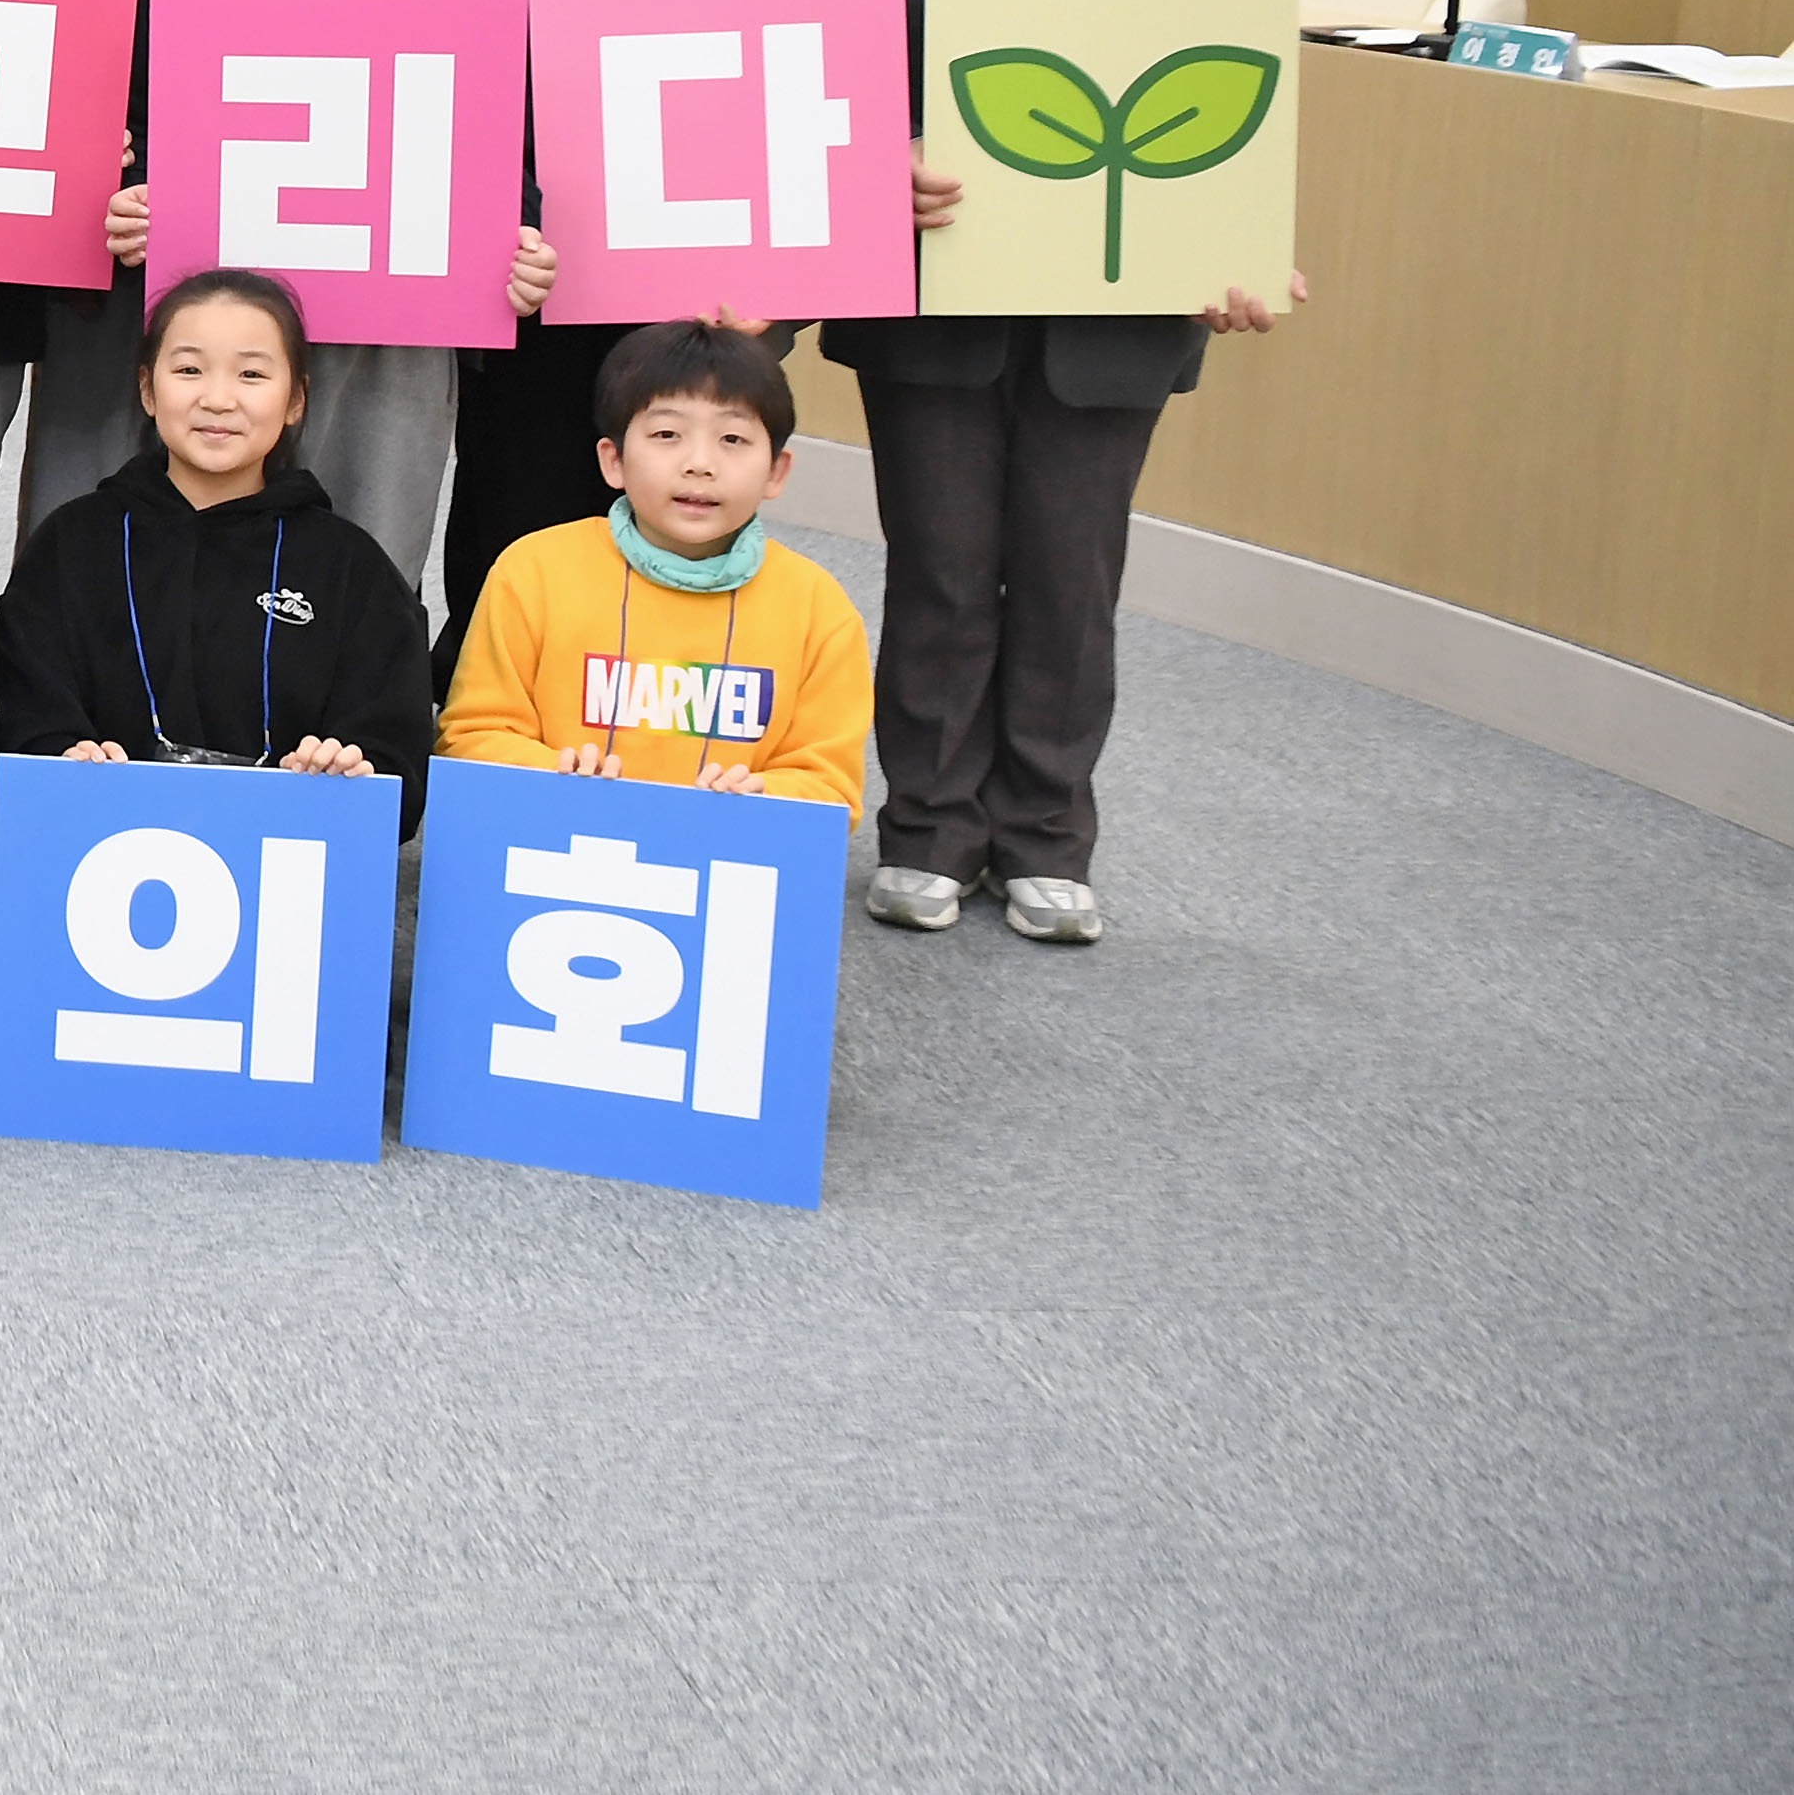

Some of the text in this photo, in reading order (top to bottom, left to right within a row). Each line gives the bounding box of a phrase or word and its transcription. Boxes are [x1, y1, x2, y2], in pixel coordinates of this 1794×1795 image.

[218, 53, 455, 277] 리
[599, 22, 851, 250] 다
[584, 658, 766, 739] MARVEL
[54, 828, 327, 1084] 의
[489, 834, 778, 1120] 회
